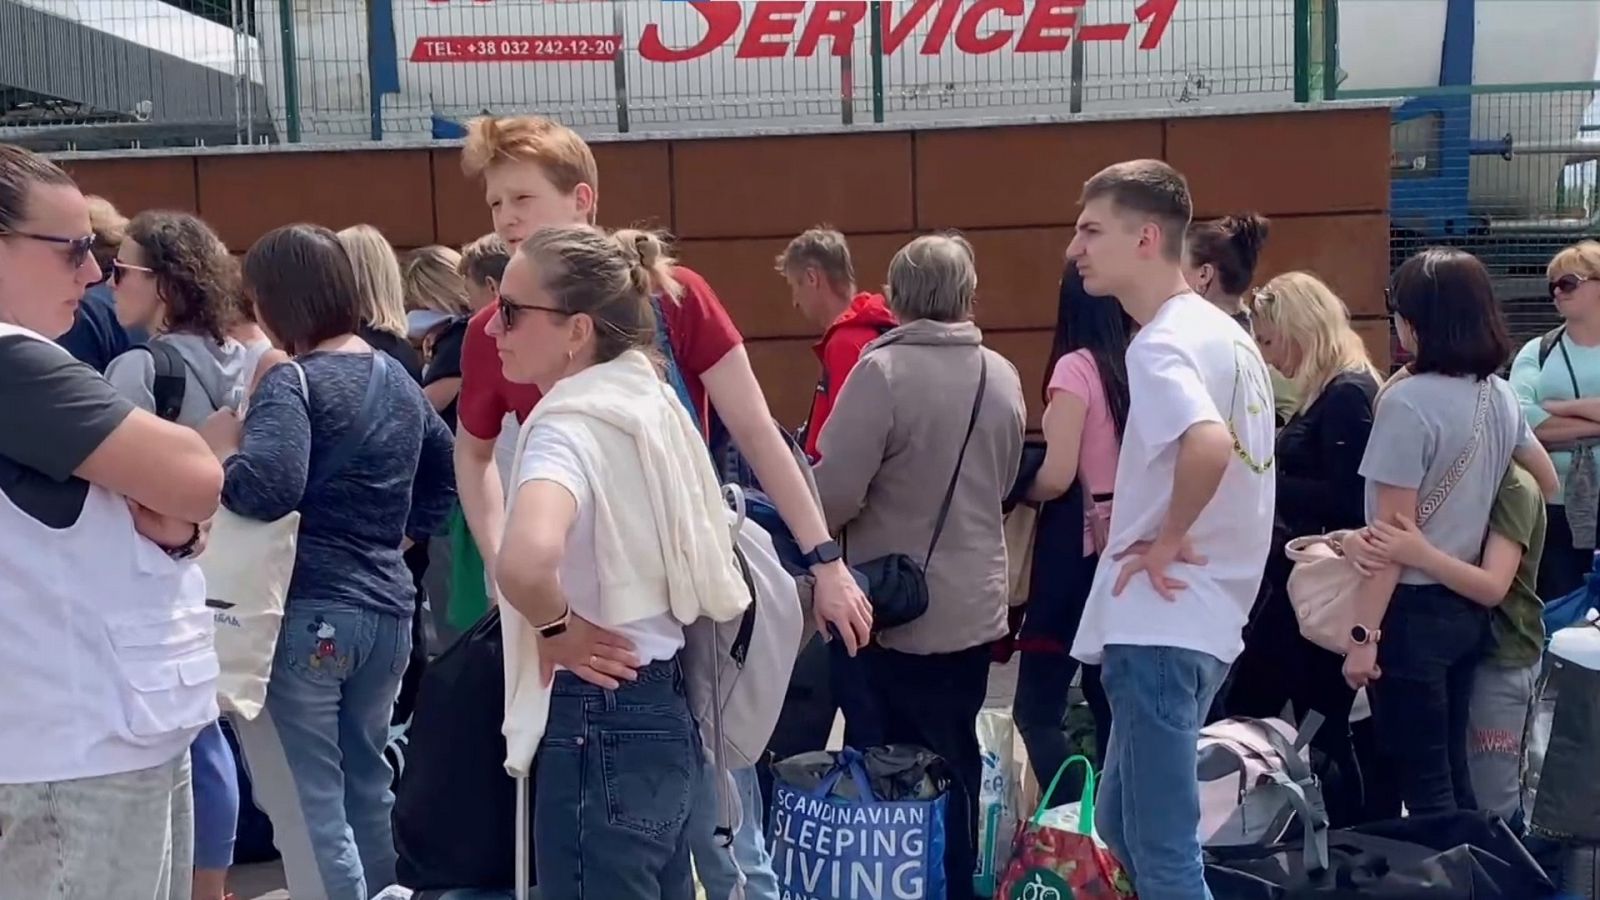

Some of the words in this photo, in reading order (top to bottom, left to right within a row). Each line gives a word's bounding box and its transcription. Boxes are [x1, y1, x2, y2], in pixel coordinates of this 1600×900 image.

[424, 41, 462, 56] TEL:
[467, 40, 496, 55] +38
[501, 40, 530, 55] 032
[535, 40, 615, 55] 242-12-20
[777, 789, 924, 825] SCANDINAVIAN
[774, 809, 924, 857] SLEEPING
